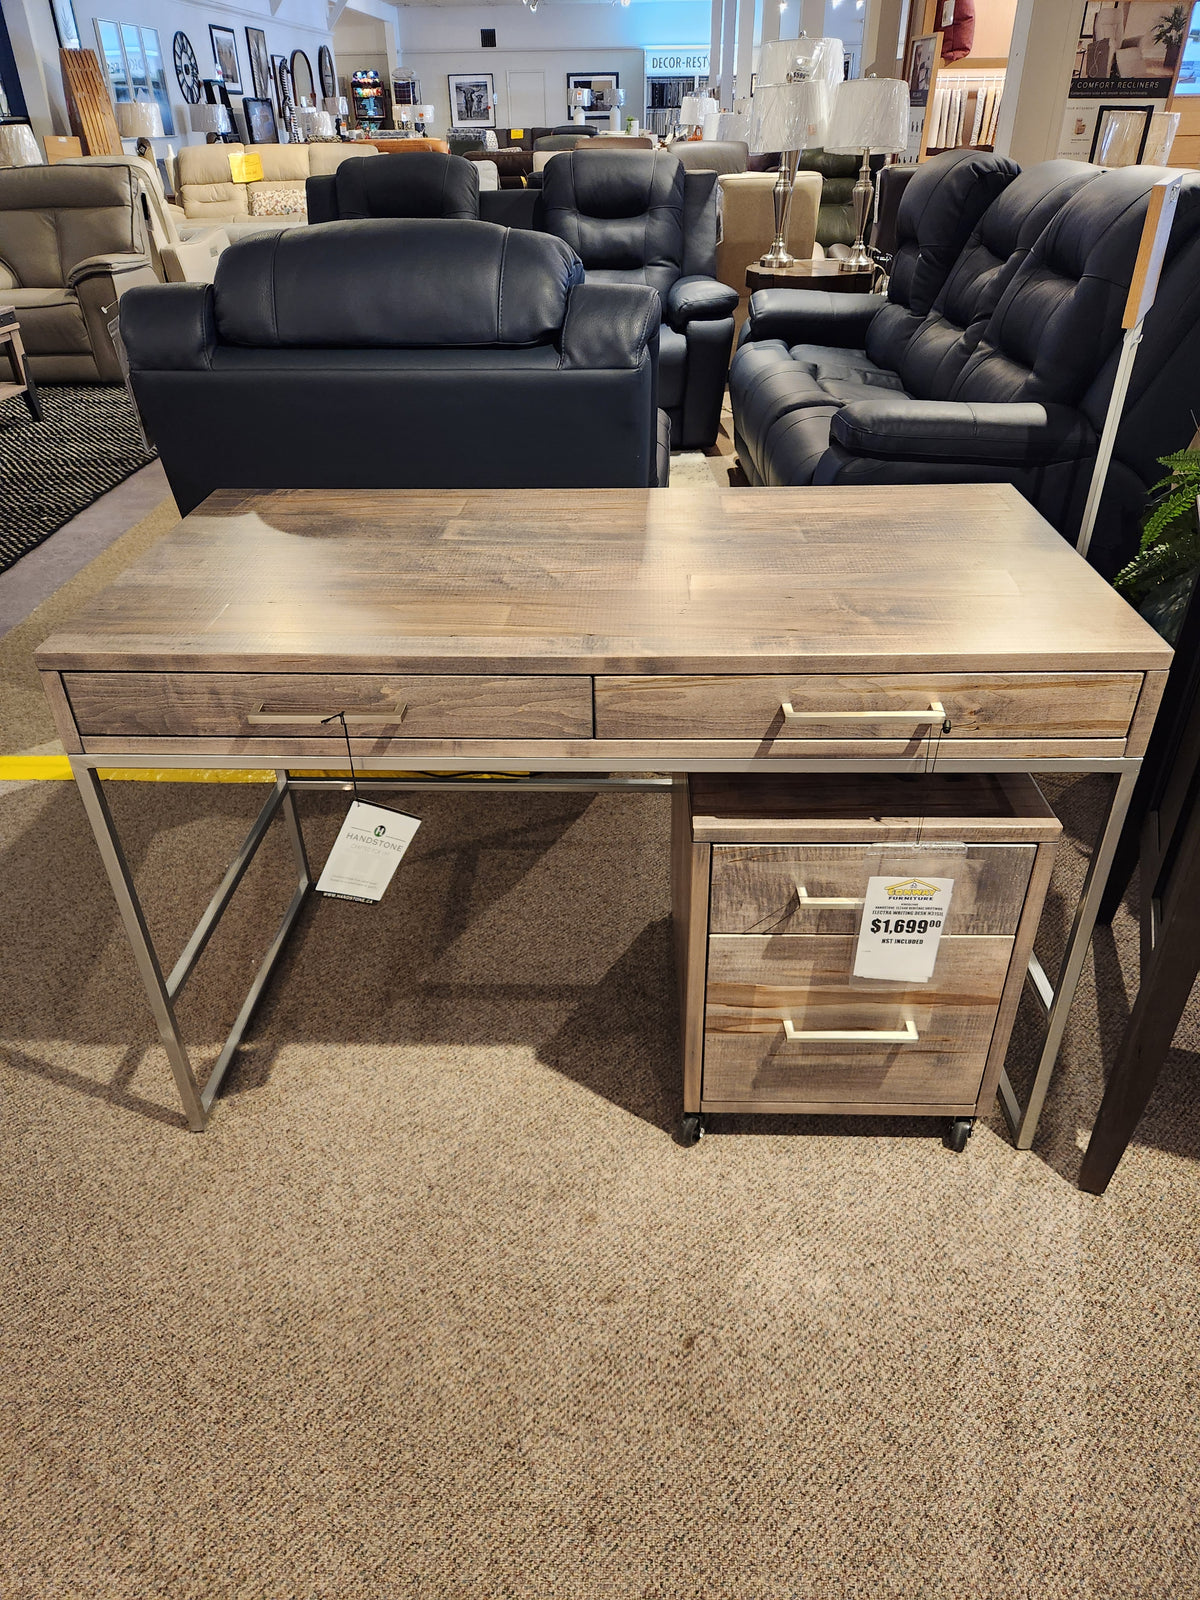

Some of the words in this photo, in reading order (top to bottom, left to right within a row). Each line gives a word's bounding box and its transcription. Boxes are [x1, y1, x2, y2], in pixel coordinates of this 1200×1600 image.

[652, 56, 708, 69] DECOR-REST
[1077, 81, 1115, 89] COMFORT
[1117, 81, 1160, 89] RECLINERS
[346, 832, 404, 853] HANDSTONE
